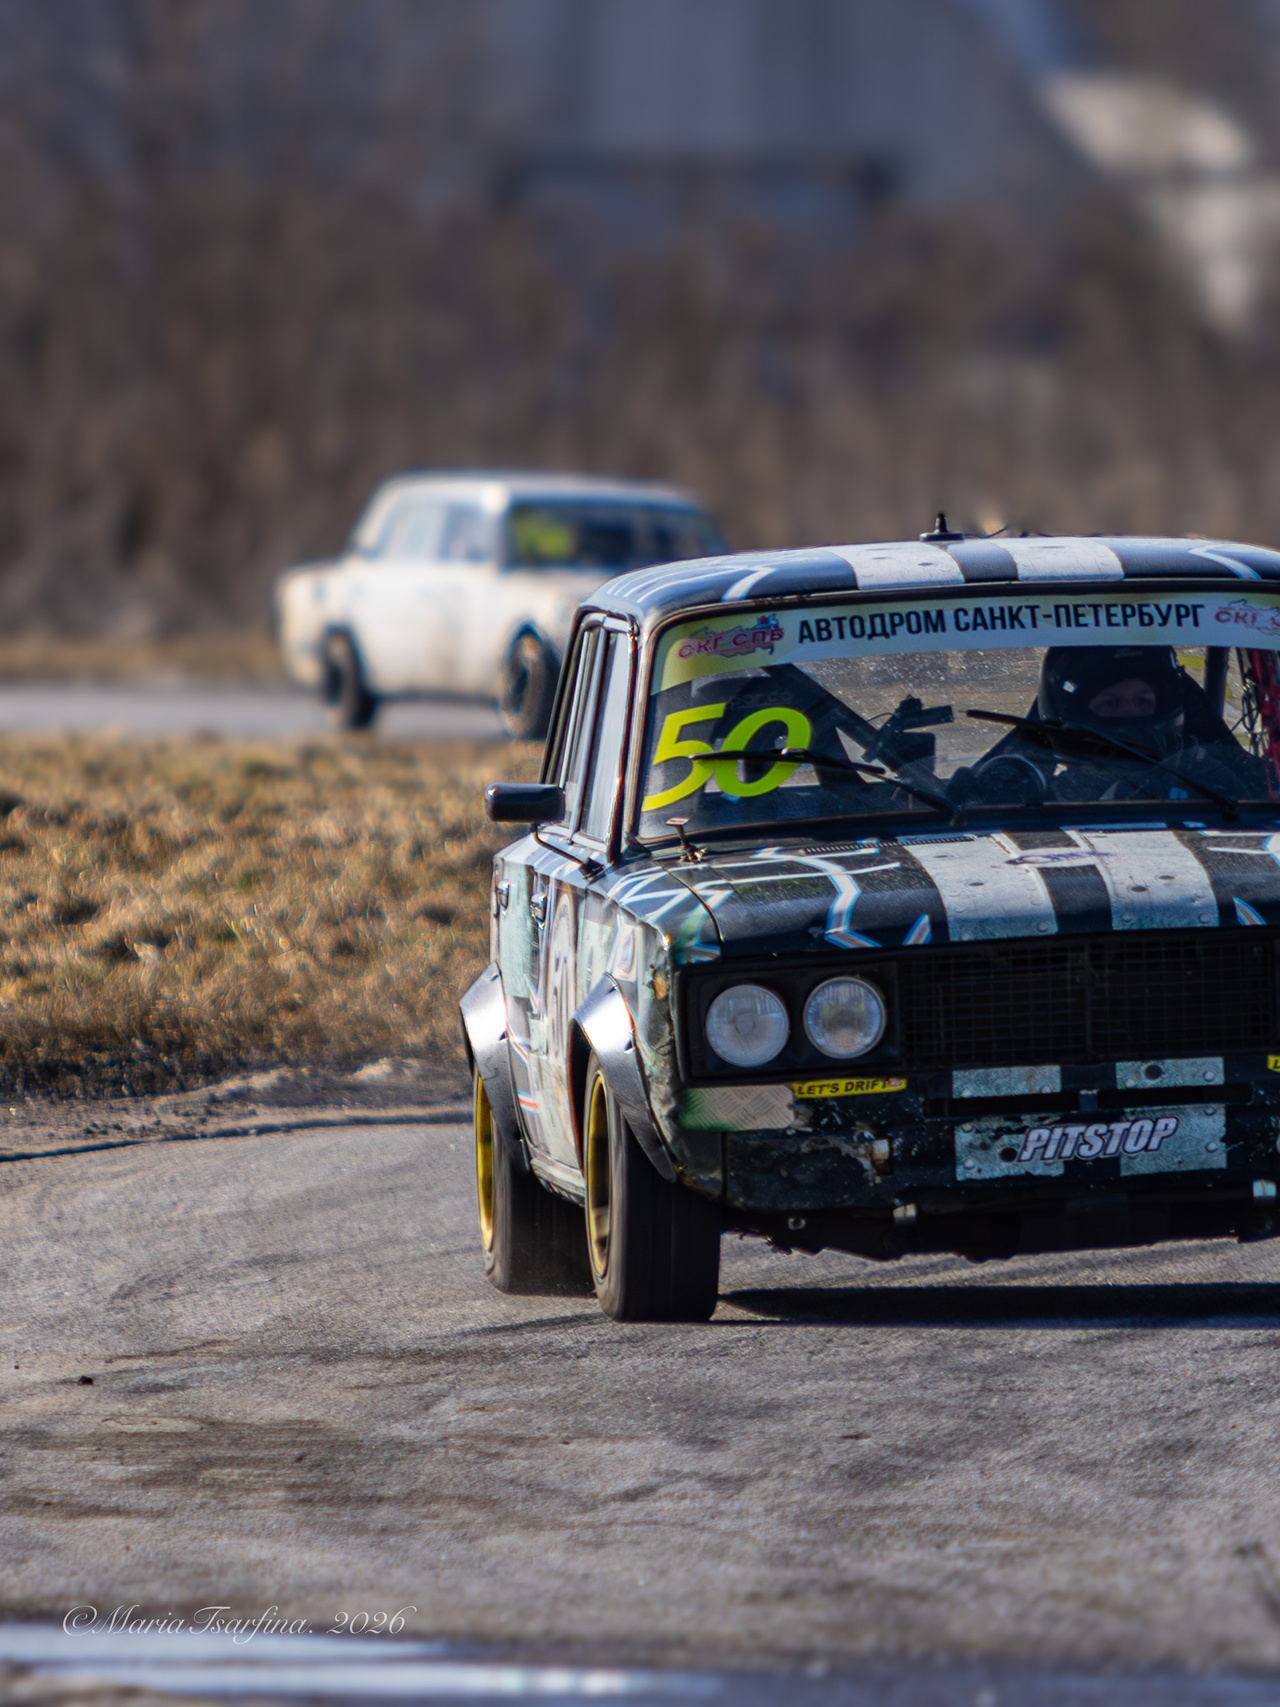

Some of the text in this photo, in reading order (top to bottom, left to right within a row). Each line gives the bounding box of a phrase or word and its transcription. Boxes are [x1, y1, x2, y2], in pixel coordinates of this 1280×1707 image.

[678, 627, 784, 658] СКГ СПБ
[798, 603, 1205, 643] АВТОДРОМ САНКТ-ПЕТЕРБУРГ
[641, 702, 811, 812] 50
[797, 1083, 839, 1095] LET'S
[844, 1079, 888, 1092] DRIFT
[1018, 1115, 1180, 1162] PITSTOP
